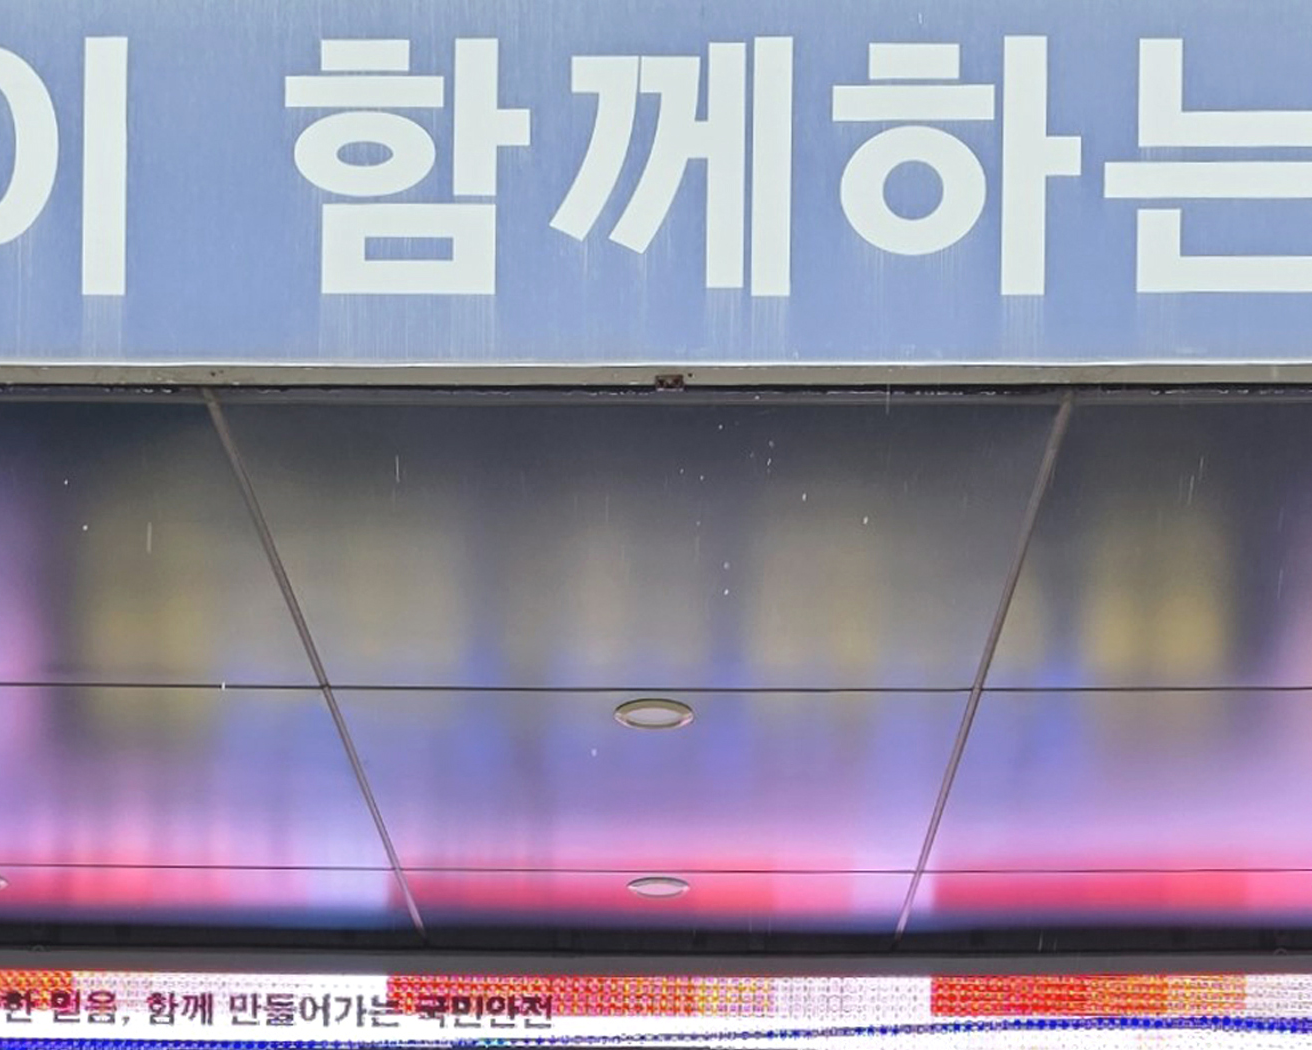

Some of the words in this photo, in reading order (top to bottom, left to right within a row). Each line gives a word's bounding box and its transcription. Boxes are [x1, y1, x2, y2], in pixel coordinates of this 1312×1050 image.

[147, 992, 213, 1026] 함께
[229, 993, 400, 1027] 만들어가는
[417, 994, 553, 1028] 국민안전
